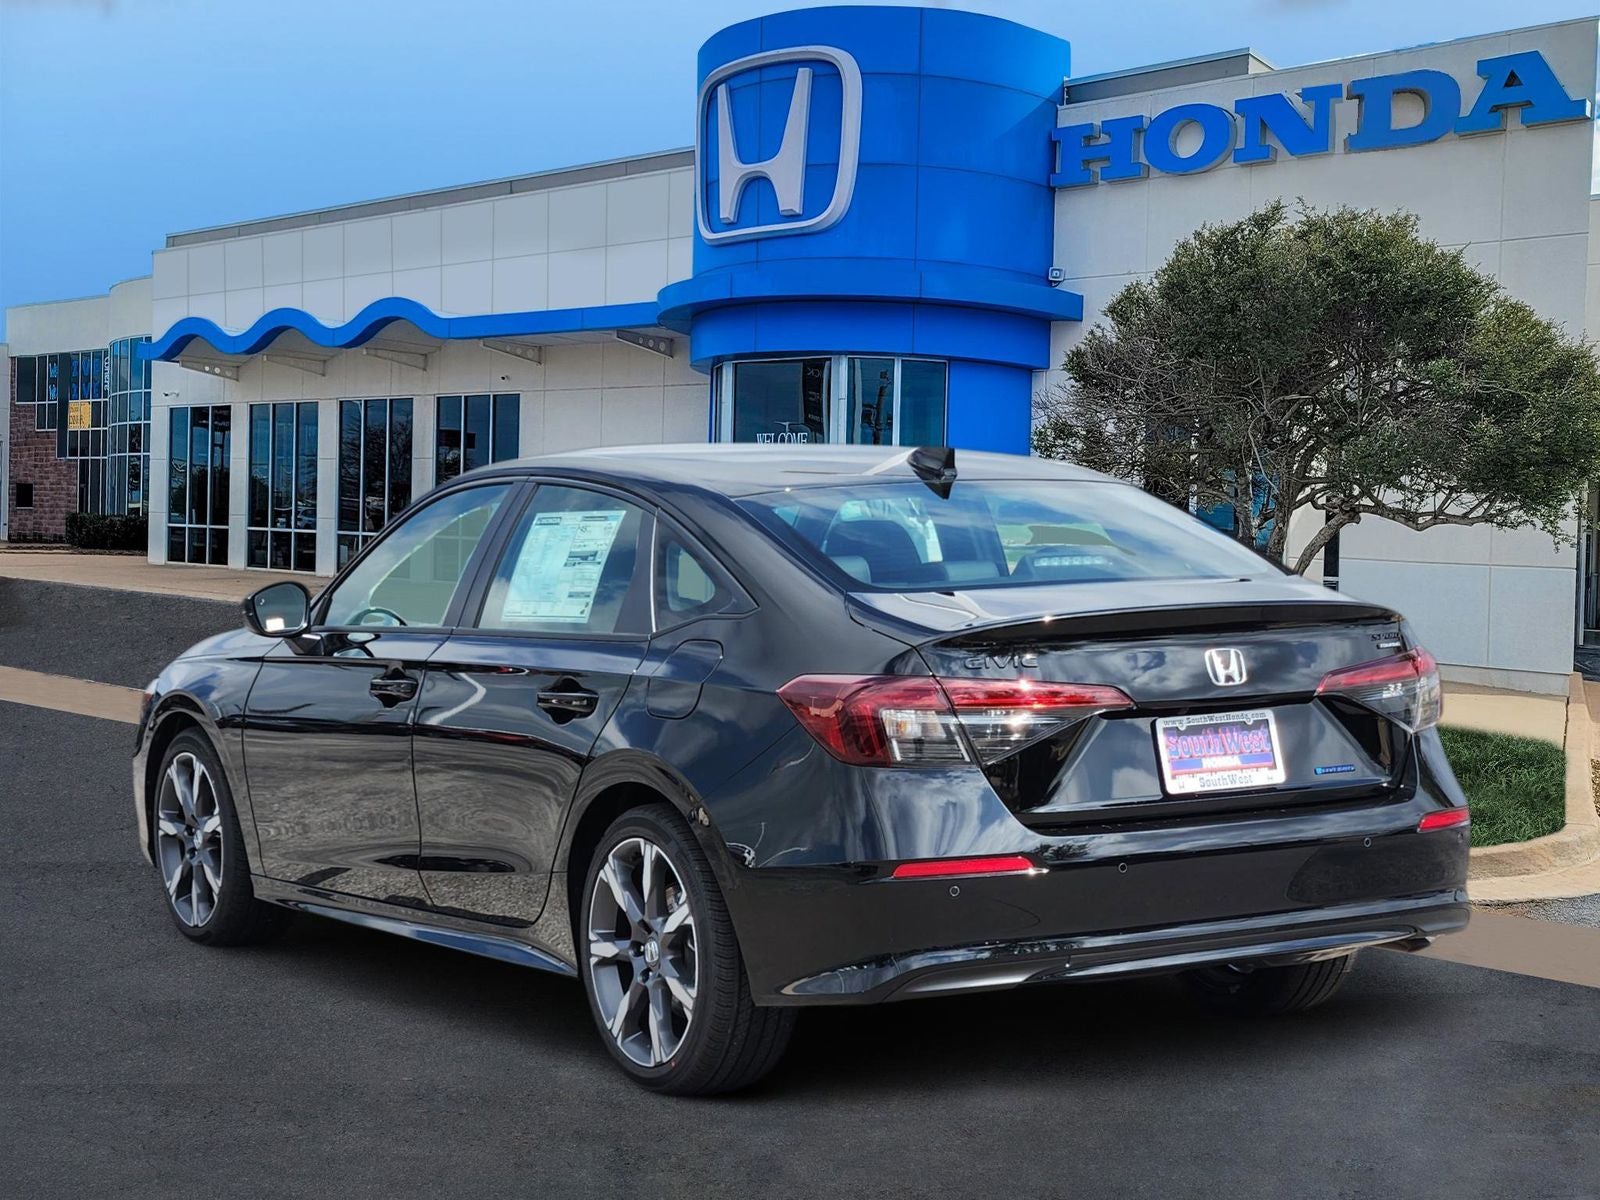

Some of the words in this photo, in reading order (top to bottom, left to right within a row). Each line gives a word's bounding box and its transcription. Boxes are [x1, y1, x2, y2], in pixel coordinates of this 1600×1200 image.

[1050, 50, 1591, 188] HONDA
[964, 654, 1039, 669] CIVIC
[1165, 723, 1271, 760] SouthWest
[1198, 773, 1254, 789] SouthWest
